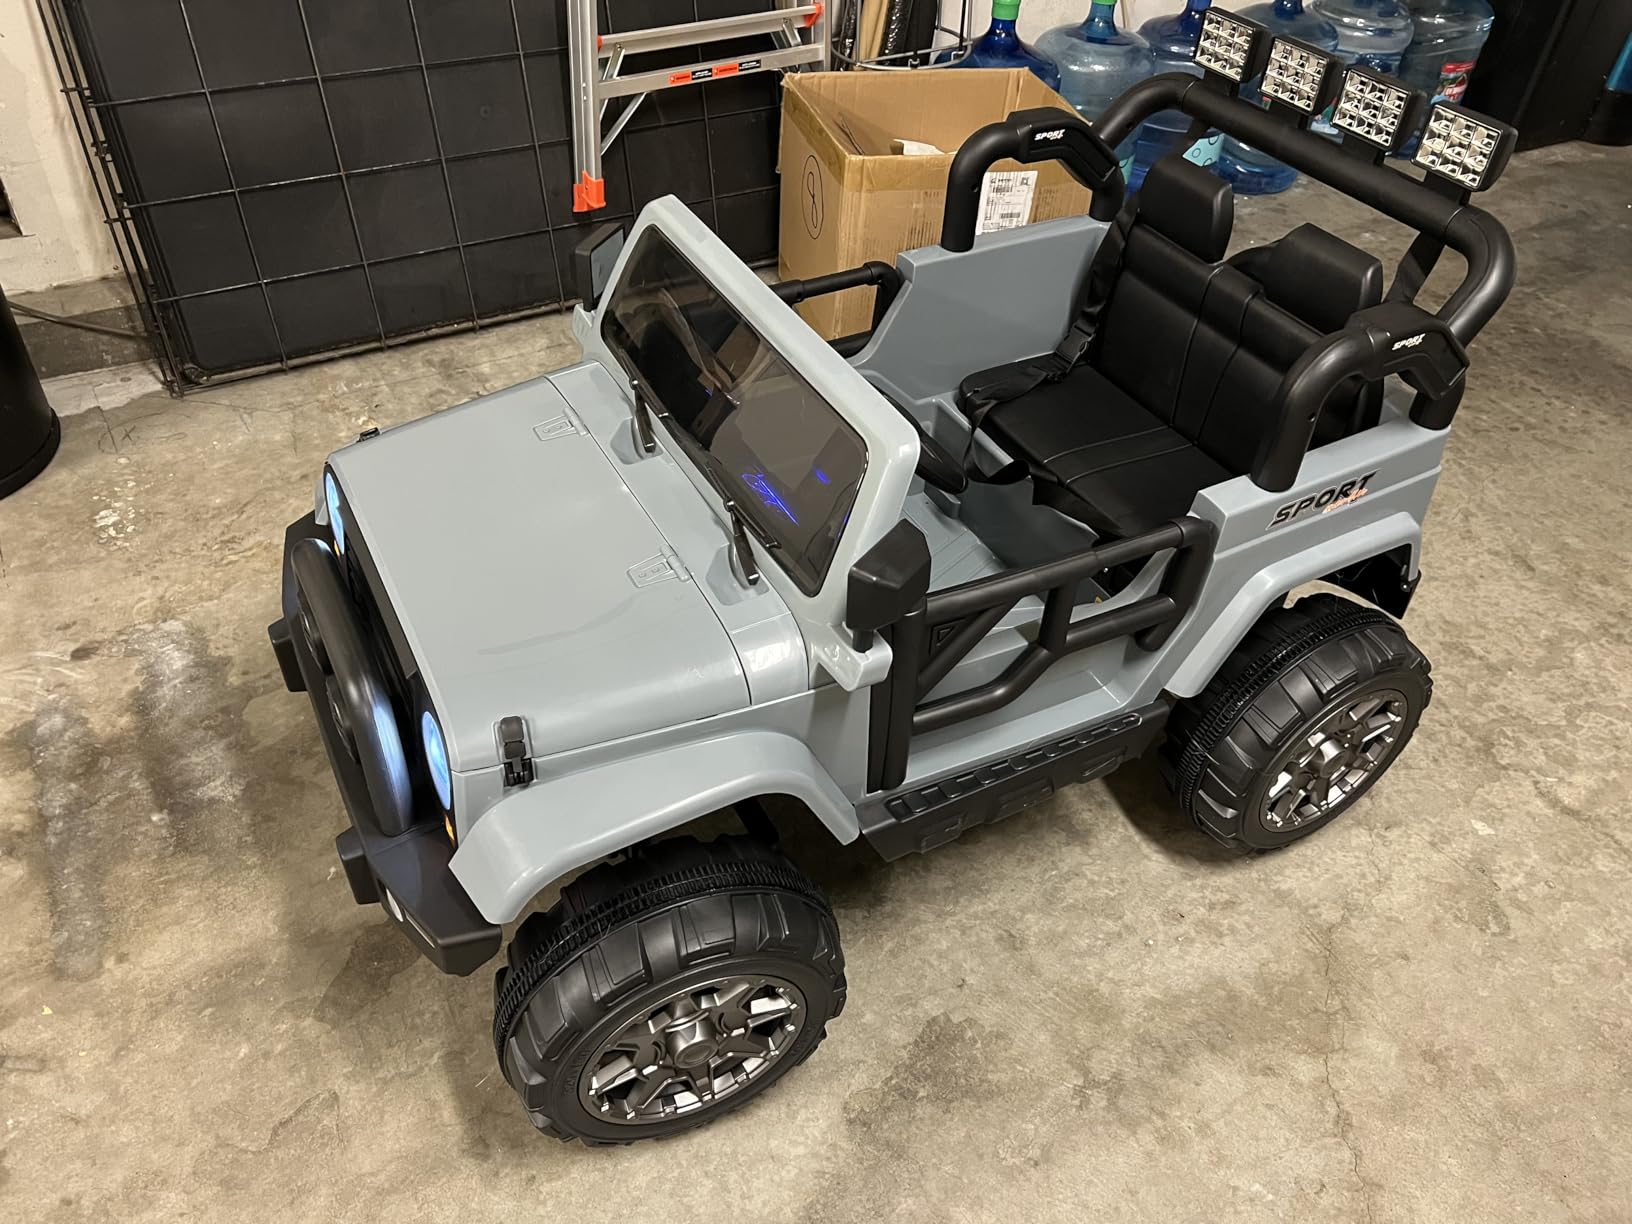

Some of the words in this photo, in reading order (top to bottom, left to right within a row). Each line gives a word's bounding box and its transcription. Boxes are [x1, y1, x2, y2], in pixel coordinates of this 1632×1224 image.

[1034, 128, 1066, 141] SPORT
[1391, 332, 1426, 351] SPORT
[1267, 470, 1378, 529] SPORT
